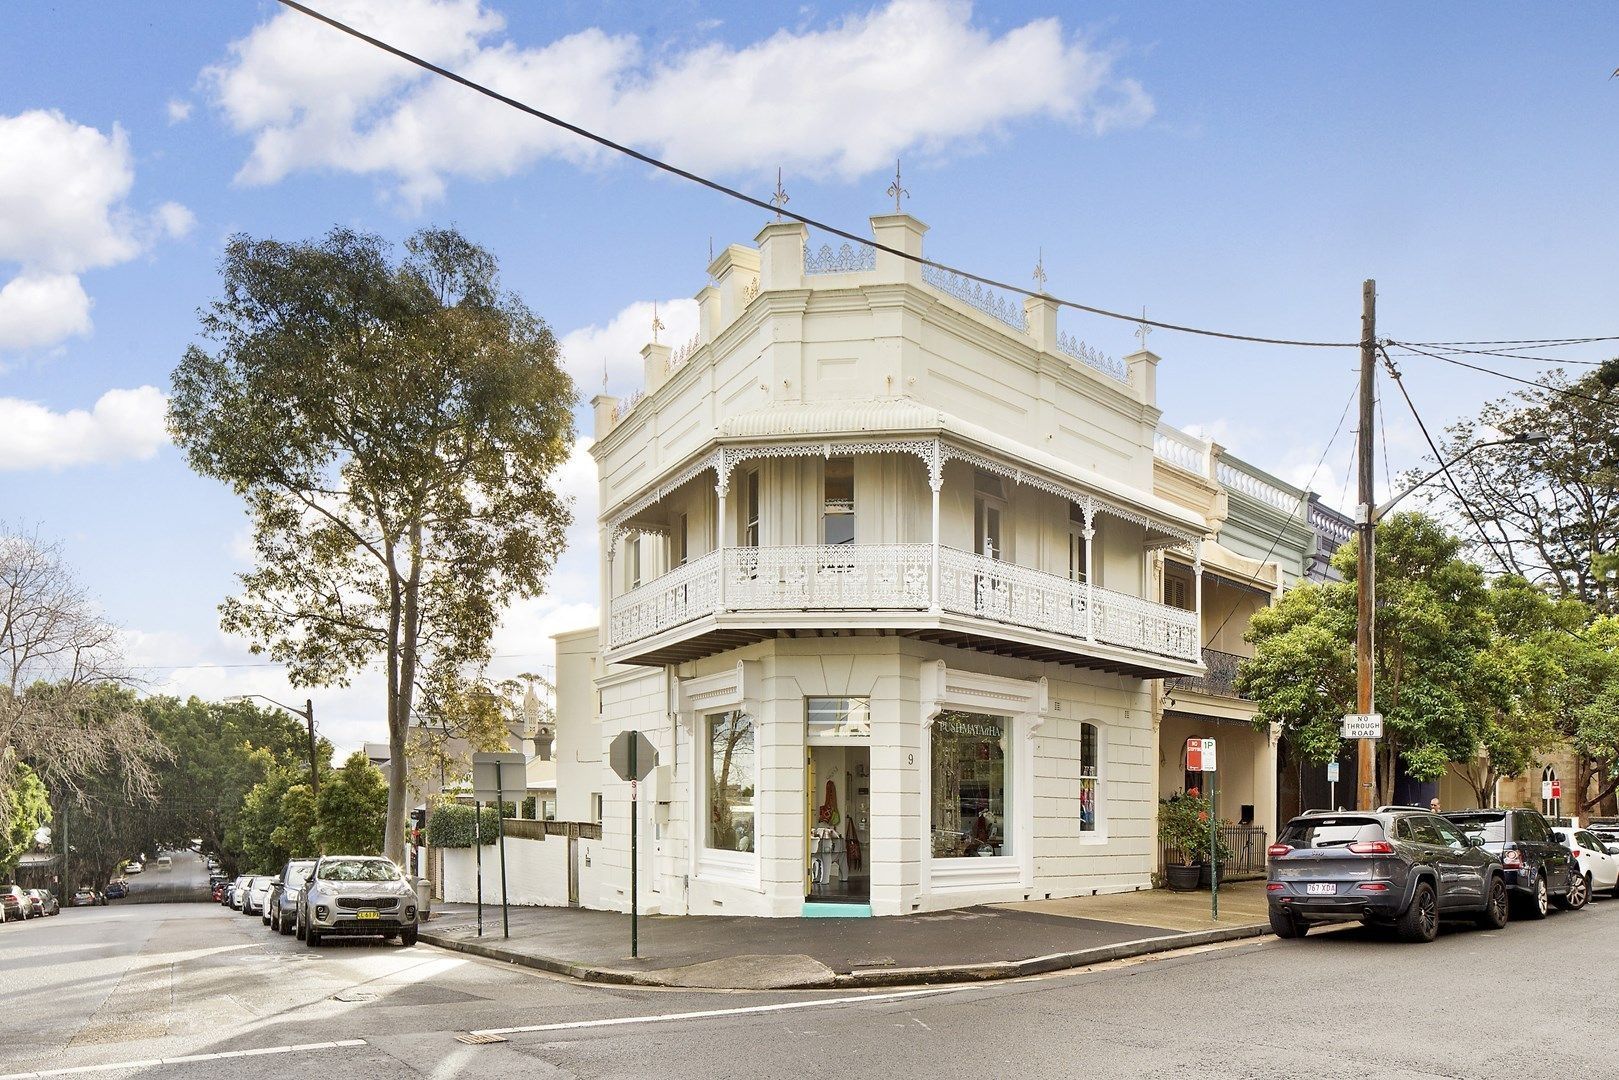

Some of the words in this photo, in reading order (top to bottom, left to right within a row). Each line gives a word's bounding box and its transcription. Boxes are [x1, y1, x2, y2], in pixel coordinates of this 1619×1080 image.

[1346, 722, 1380, 730] THROUGH
[1204, 741, 1214, 749] 1P
[908, 753, 914, 766] 9
[1308, 884, 1320, 892] 767
[1321, 884, 1335, 892] XDA
